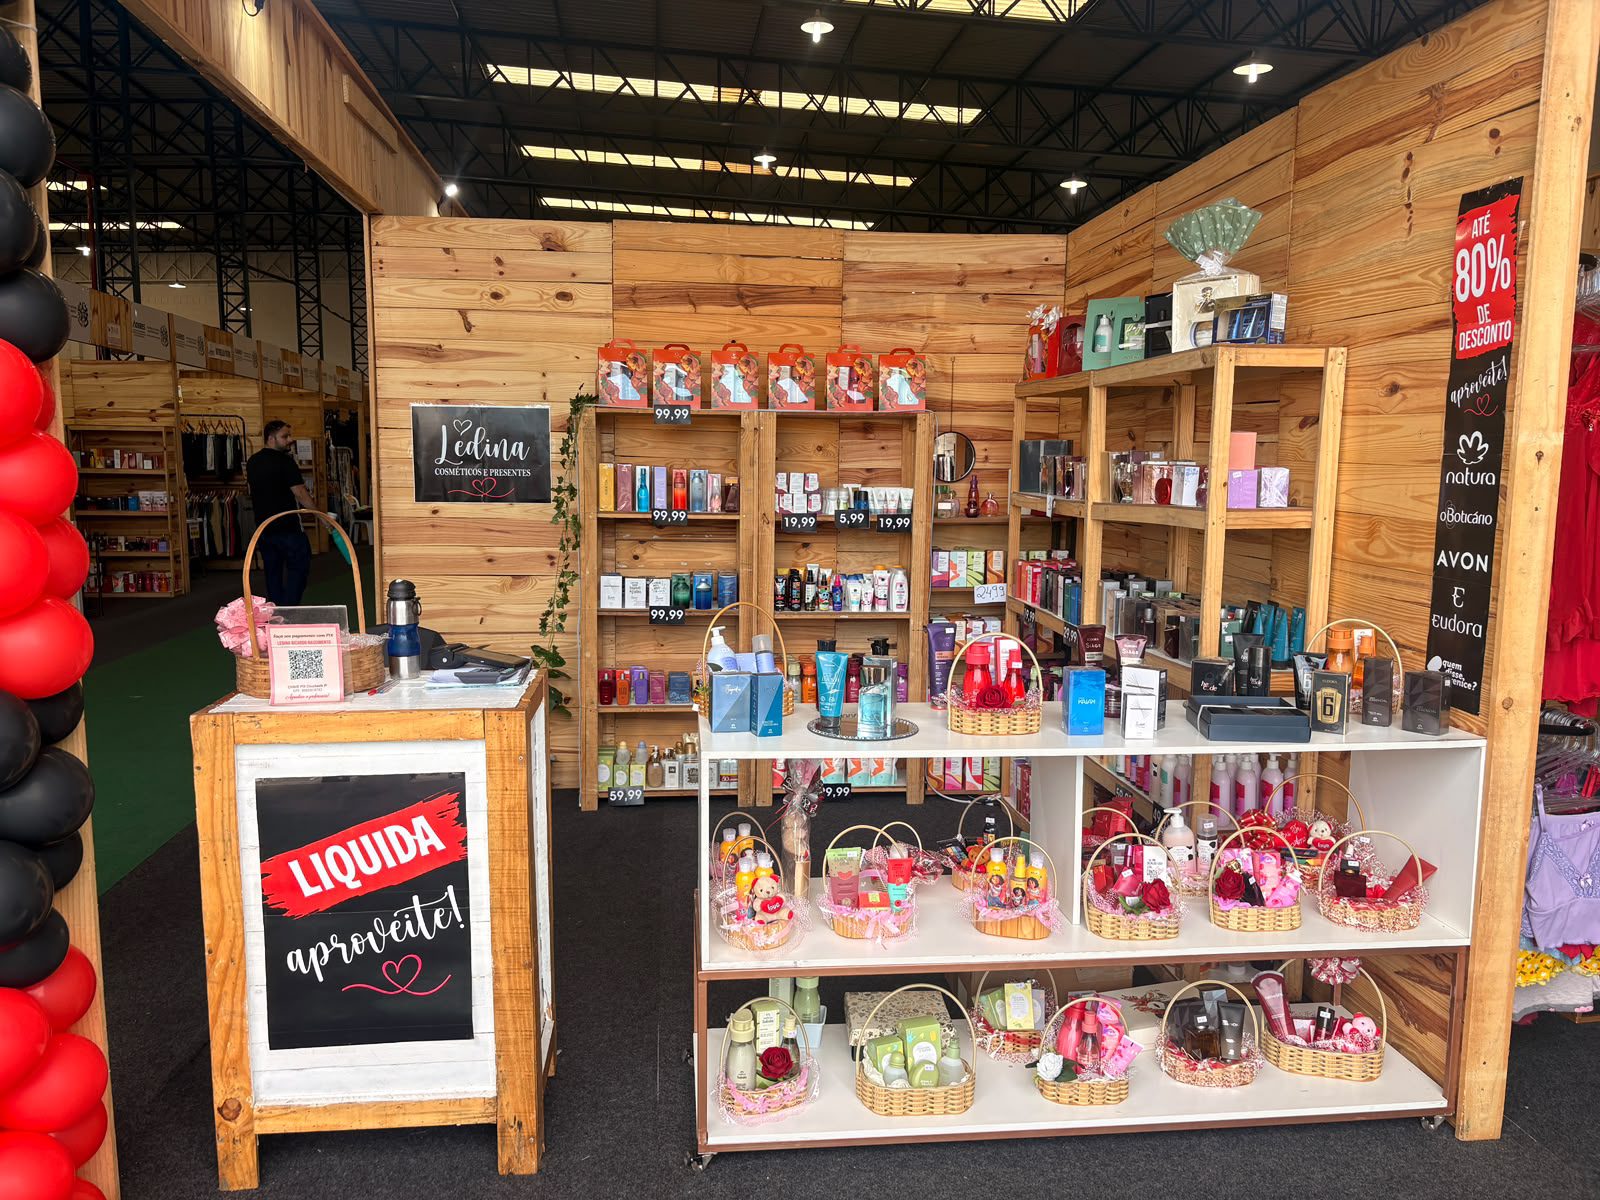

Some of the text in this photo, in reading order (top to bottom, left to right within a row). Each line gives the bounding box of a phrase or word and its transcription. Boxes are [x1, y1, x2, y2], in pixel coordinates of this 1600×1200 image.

[1471, 210, 1491, 239] ATÉ
[1455, 234, 1511, 303] 80%
[1476, 303, 1491, 325] DE
[1459, 319, 1512, 351] DESCONTO
[1450, 355, 1507, 408] aproveite!
[655, 408, 689, 421] 99,99
[434, 424, 530, 466] Ledina
[434, 466, 532, 477] COSMÉTICOS E PRESENTES
[1445, 467, 1496, 486] natura
[653, 510, 687, 522] 99,99
[783, 516, 816, 528] 19,99
[839, 513, 865, 525] 5,99
[879, 517, 911, 529] 19,99
[1436, 549, 1489, 573] AVON
[650, 609, 684, 621] 99,99
[1442, 659, 1462, 671] quem
[1323, 696, 1334, 717] 6
[609, 789, 642, 801] 59,99
[822, 786, 850, 798] 9,99
[287, 815, 446, 898] LIQUIDA
[286, 884, 466, 984] aproveite!
